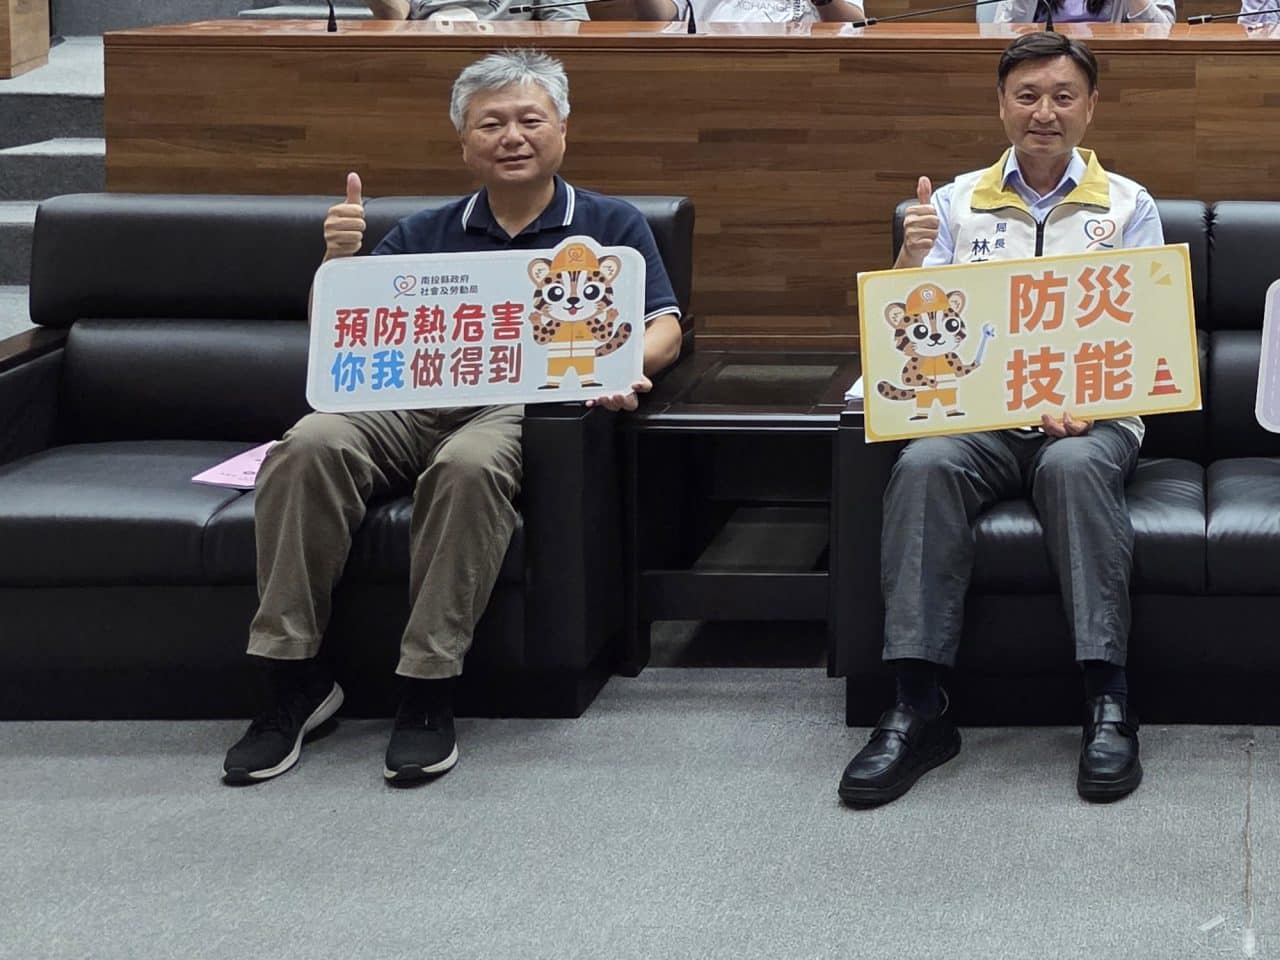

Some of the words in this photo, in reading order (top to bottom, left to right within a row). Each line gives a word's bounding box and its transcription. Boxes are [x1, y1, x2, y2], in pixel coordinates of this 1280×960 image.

[970, 237, 991, 263] 林
[334, 300, 526, 349] 預防熱危害
[1008, 263, 1135, 336] 防災
[330, 342, 523, 393] 你我做得到
[1005, 340, 1133, 412] 技能
